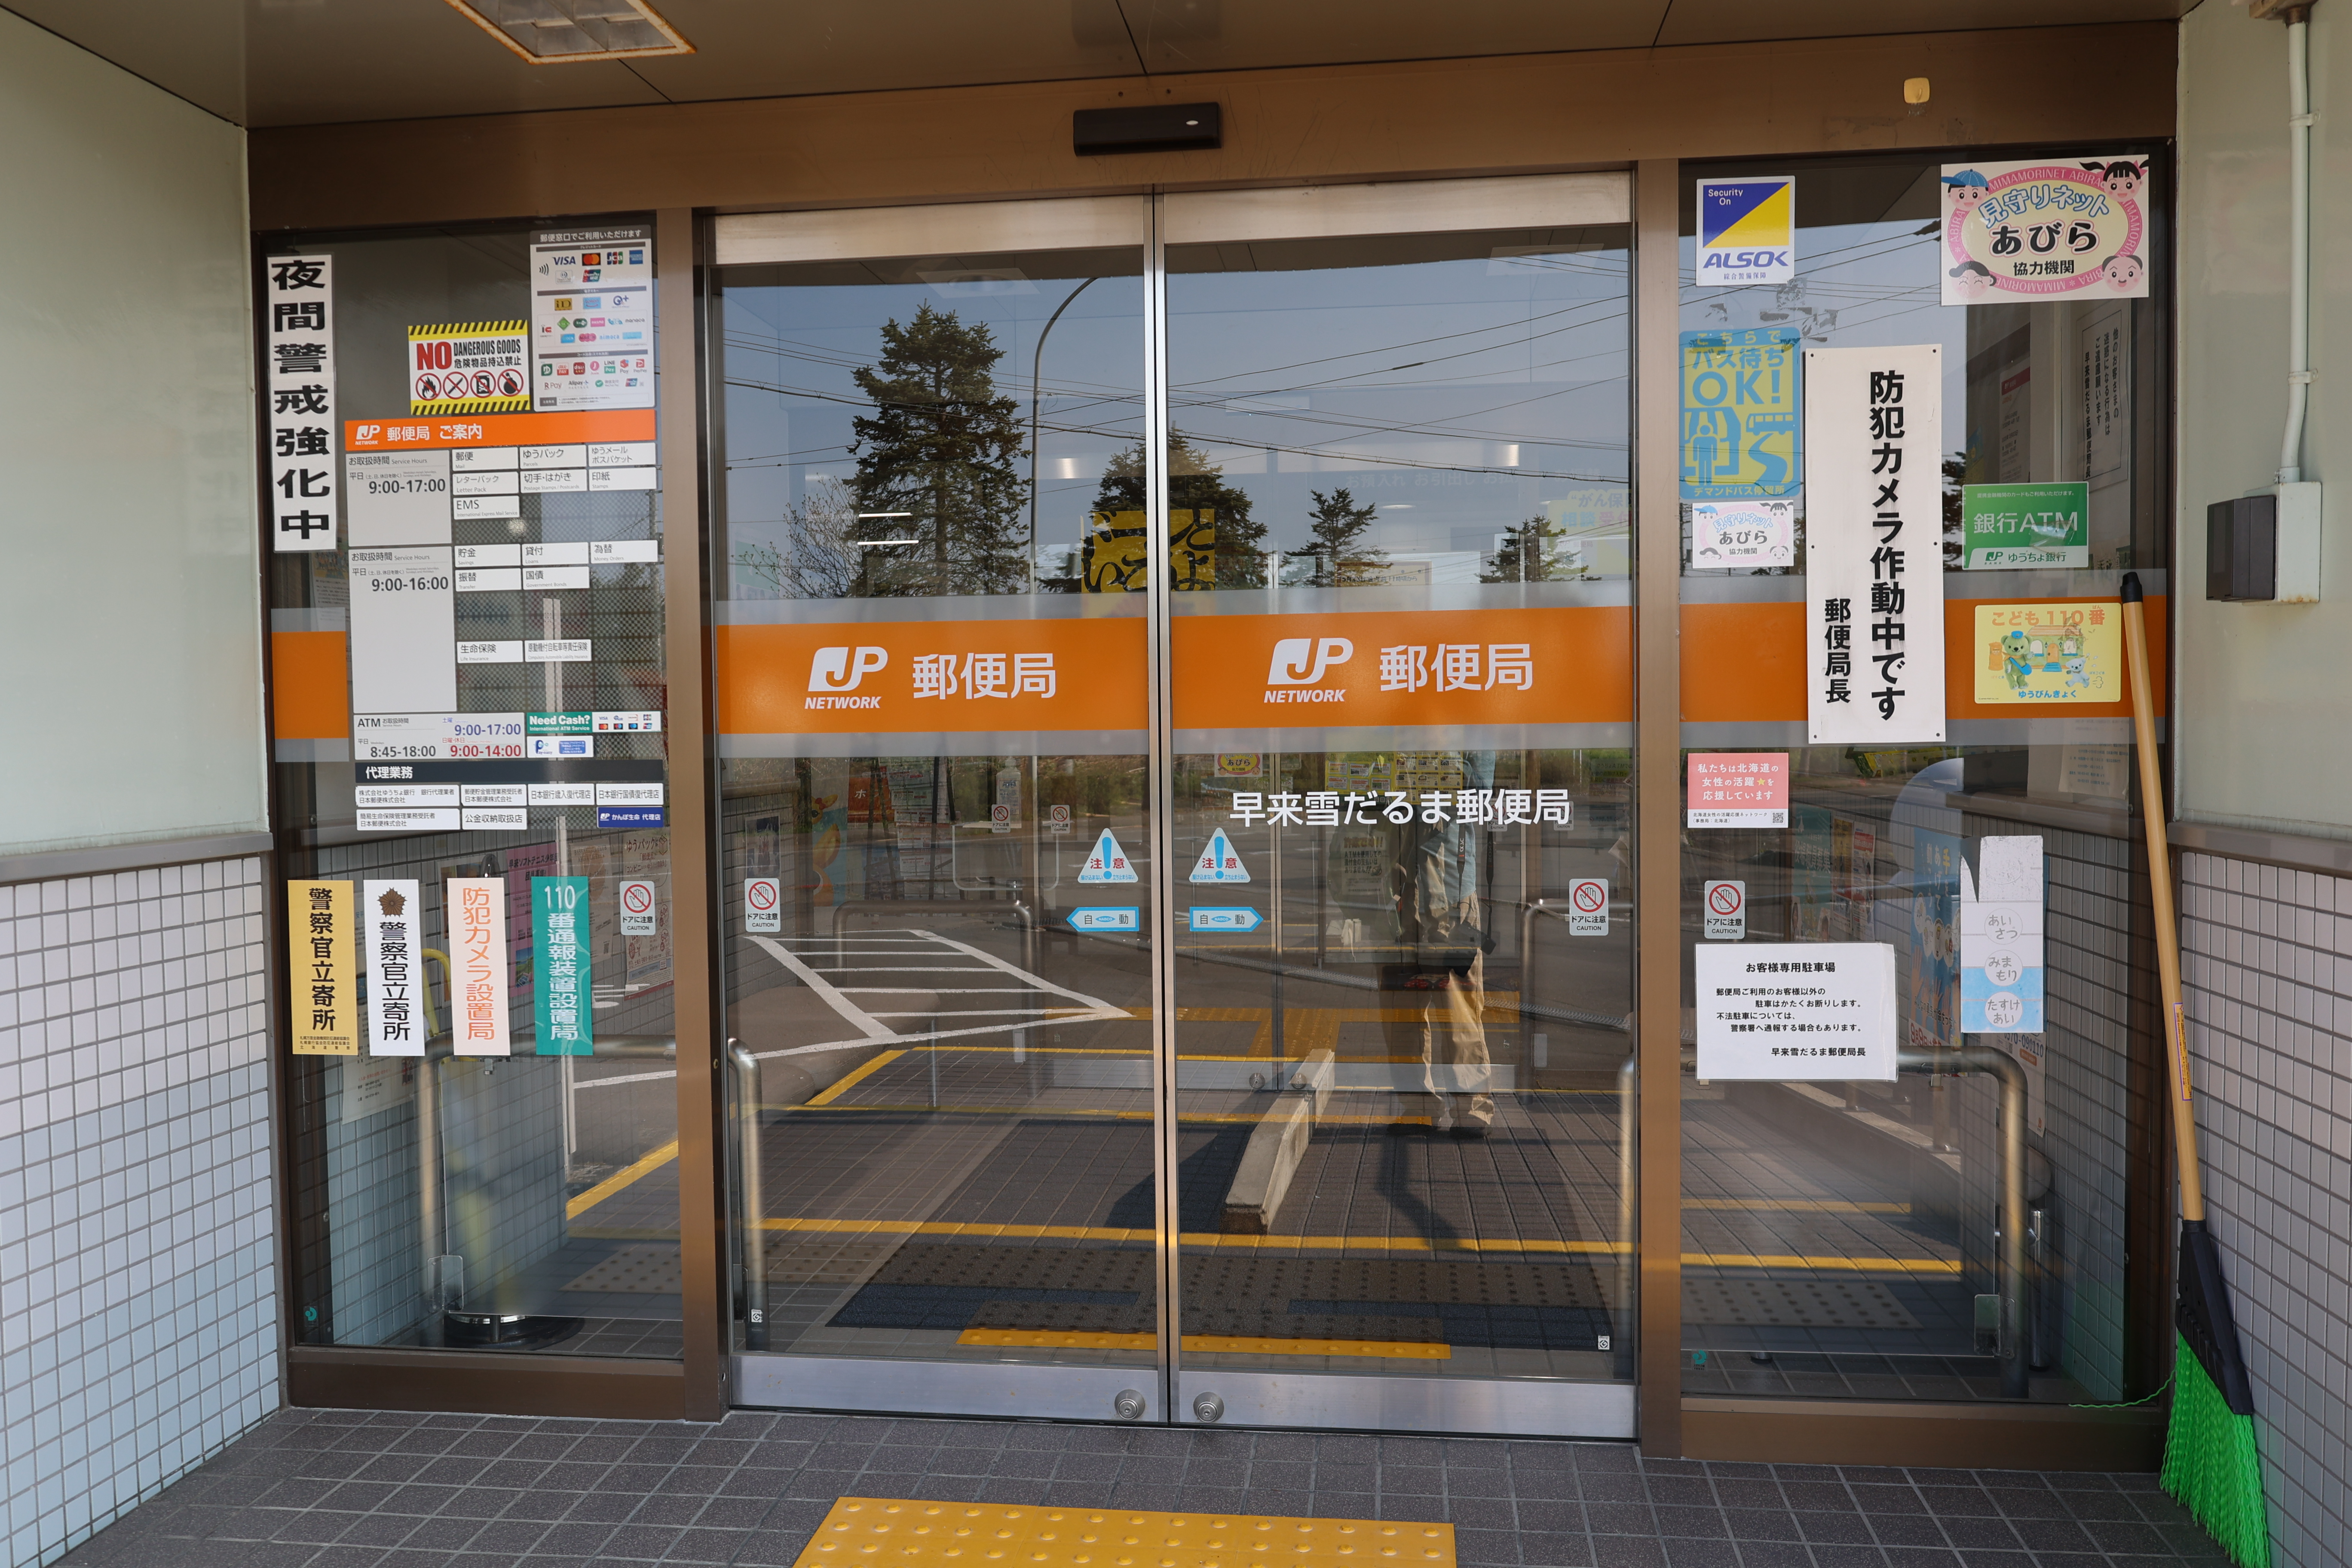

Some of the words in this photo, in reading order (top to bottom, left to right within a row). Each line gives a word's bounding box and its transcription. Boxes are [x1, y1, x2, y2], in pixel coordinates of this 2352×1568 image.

[1708, 188, 1743, 197] Security
[1719, 197, 1731, 205] On
[1978, 184, 2110, 229] 見守りネット
[540, 230, 641, 242] 郵便窓口でご利用いただけます
[1991, 221, 2098, 255] あびら
[552, 256, 576, 266] VISA
[1703, 251, 1789, 269] ALSOK
[2013, 260, 2075, 276] 協力機関
[1697, 330, 1781, 345] こちらで
[416, 341, 452, 371] NO
[453, 340, 495, 357] DANGEROUS
[496, 339, 521, 354] GOODS
[1692, 347, 1785, 370] バス待ち
[453, 355, 522, 369] 危険物品持込禁止
[1691, 369, 1781, 407] OK!
[271, 260, 331, 541] 夜間警戒強化中
[386, 426, 430, 442] 郵便局
[439, 423, 483, 440] ご案内
[523, 448, 564, 459] ゆうパック
[591, 446, 628, 455] ゆうメール
[348, 456, 390, 466] お取扱時間
[455, 451, 474, 462] 郵便
[592, 455, 633, 464] ポスパケット
[349, 472, 364, 480] 平日
[456, 475, 499, 484] レターパック
[591, 471, 610, 481] 印紙
[368, 478, 446, 494] 9:00-17:00
[1694, 484, 1785, 496] デマンドバス停留所
[1977, 490, 2075, 499] 提携金融機関のカードもご利用いただけます。
[456, 499, 480, 510] EMS
[1713, 513, 1773, 533] 見守りネット
[1973, 511, 2078, 534] 銀行ATM
[1719, 530, 1768, 545] あびら
[525, 545, 543, 556] 貸付
[594, 544, 612, 554] 為替
[1729, 547, 1758, 555] 協力機関
[1869, 370, 1905, 721] 防犯カメラ作動中です
[351, 551, 392, 562] お取扱時間
[458, 548, 476, 558] 貯金
[2008, 551, 2067, 563] ゆうちょ銀行
[352, 568, 366, 576] 平日
[458, 572, 477, 582] 振替
[525, 570, 544, 580] 国債
[371, 576, 449, 592] 9:00-16:00
[460, 643, 497, 654] 生命保険
[528, 642, 588, 652] 原動機付自転車等責任保険
[1824, 597, 1851, 704] 郵便局長
[1379, 643, 1533, 693] 郵便局
[912, 652, 1056, 700] 郵便局
[1263, 689, 1346, 704] NETWORK
[2018, 689, 2077, 699] ゆうびんきょく
[804, 695, 882, 710] NETWORK
[357, 718, 381, 728] ATM
[529, 715, 556, 725] Need
[558, 714, 591, 725] Cash?
[454, 723, 521, 736] 9:00-17:00
[370, 745, 436, 757] 8:45-18:00
[450, 744, 521, 757] 9:00-14:00
[365, 766, 413, 779] 代理業務
[1697, 763, 1779, 774] 私たちは北海道の
[531, 790, 591, 799] 日本銀行歳入復代理店
[599, 789, 659, 799] 日本銀行国債復代理店
[1703, 790, 1773, 801] 応援しています
[1229, 787, 1571, 827] 早来雪だるま郵便局
[465, 813, 523, 824] 公金収納取扱店
[622, 916, 653, 924] ドアに注意
[747, 913, 778, 921] ドアに注意
[1084, 914, 1093, 925] 自
[1118, 914, 1129, 925] 動
[1199, 914, 1209, 925] 自
[1234, 914, 1245, 925] 動
[1571, 915, 1606, 924] ドアに注意
[1706, 918, 1743, 927] ドアに注意
[1988, 915, 2012, 926] あい
[1995, 928, 2018, 940] さつ
[308, 887, 336, 1032] 警察官立寄所
[462, 886, 496, 1041] 防犯カメラ設置局
[544, 885, 578, 1041] 110番通報装置設置局
[1988, 956, 2012, 968] みま
[1746, 962, 1836, 973] お客様専用駐車場
[379, 922, 410, 1041] 警察官立寄所
[1996, 970, 2018, 982] もり
[1716, 987, 1826, 996] 郵便局ご利用のお客様以外の
[1755, 999, 1862, 1008] 駐車はかたくお断りします。
[1987, 999, 2019, 1011] たすけ
[1716, 1012, 1796, 1020] 不法駐車については、
[1993, 1013, 2015, 1024] あい
[1730, 1024, 1862, 1033] 警察署へ通報する場合もあります。
[1771, 1047, 1866, 1057] 早来雪だるま郵便局長
